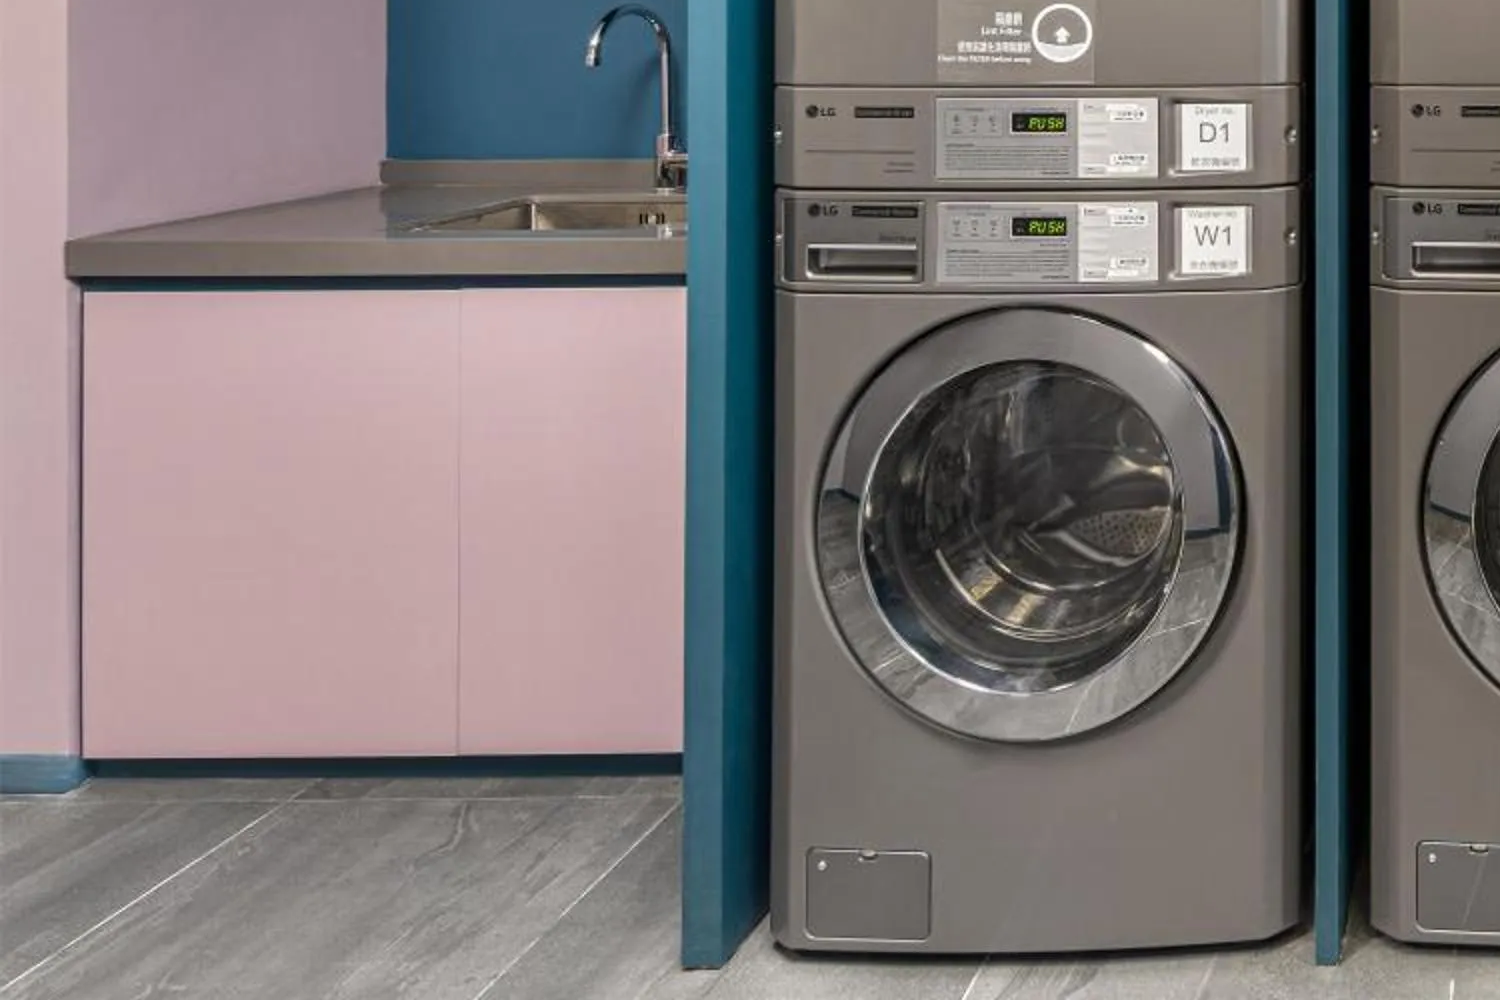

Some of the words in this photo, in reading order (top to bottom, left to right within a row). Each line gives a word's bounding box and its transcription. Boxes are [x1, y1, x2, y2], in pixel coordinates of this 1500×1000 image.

[1027, 116, 1065, 130] PUSH
[1199, 121, 1229, 143] D1
[1028, 220, 1065, 234] PUSH
[1194, 225, 1231, 246] W1
